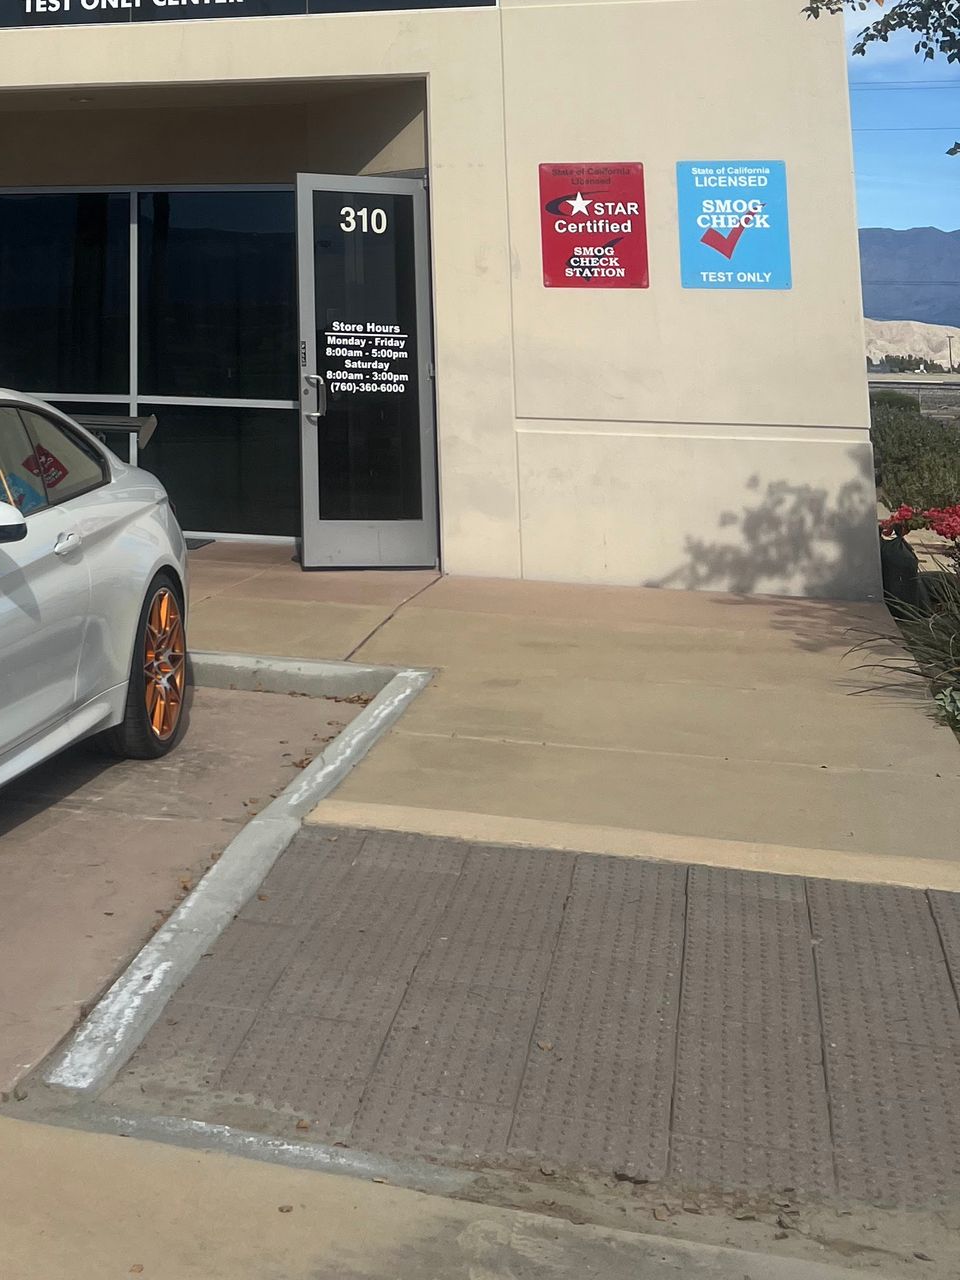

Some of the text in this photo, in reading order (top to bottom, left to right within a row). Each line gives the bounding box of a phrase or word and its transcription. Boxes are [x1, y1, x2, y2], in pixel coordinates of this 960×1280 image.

[691, 167, 714, 175] State
[727, 166, 770, 174] California
[695, 175, 768, 187] LICENSED
[593, 202, 639, 215] STAR
[702, 199, 763, 213] SMOG
[339, 206, 387, 234] 310
[554, 219, 632, 233] Certified
[696, 214, 770, 228] CHECK
[573, 246, 615, 256] SMOG
[570, 257, 620, 267] CHECK
[565, 267, 625, 277] STATION
[700, 271, 772, 283] TEST ONLY
[332, 321, 400, 333] Store Hours
[327, 336, 366, 347] Monday
[374, 337, 405, 348] Friday
[325, 347, 363, 357] 8:00am
[371, 349, 408, 360] 5:00pm
[344, 359, 390, 371] Saturday
[326, 370, 363, 380] 8:00am
[372, 371, 409, 382] 3:00pm
[330, 382, 405, 393] (760)-360-6000
